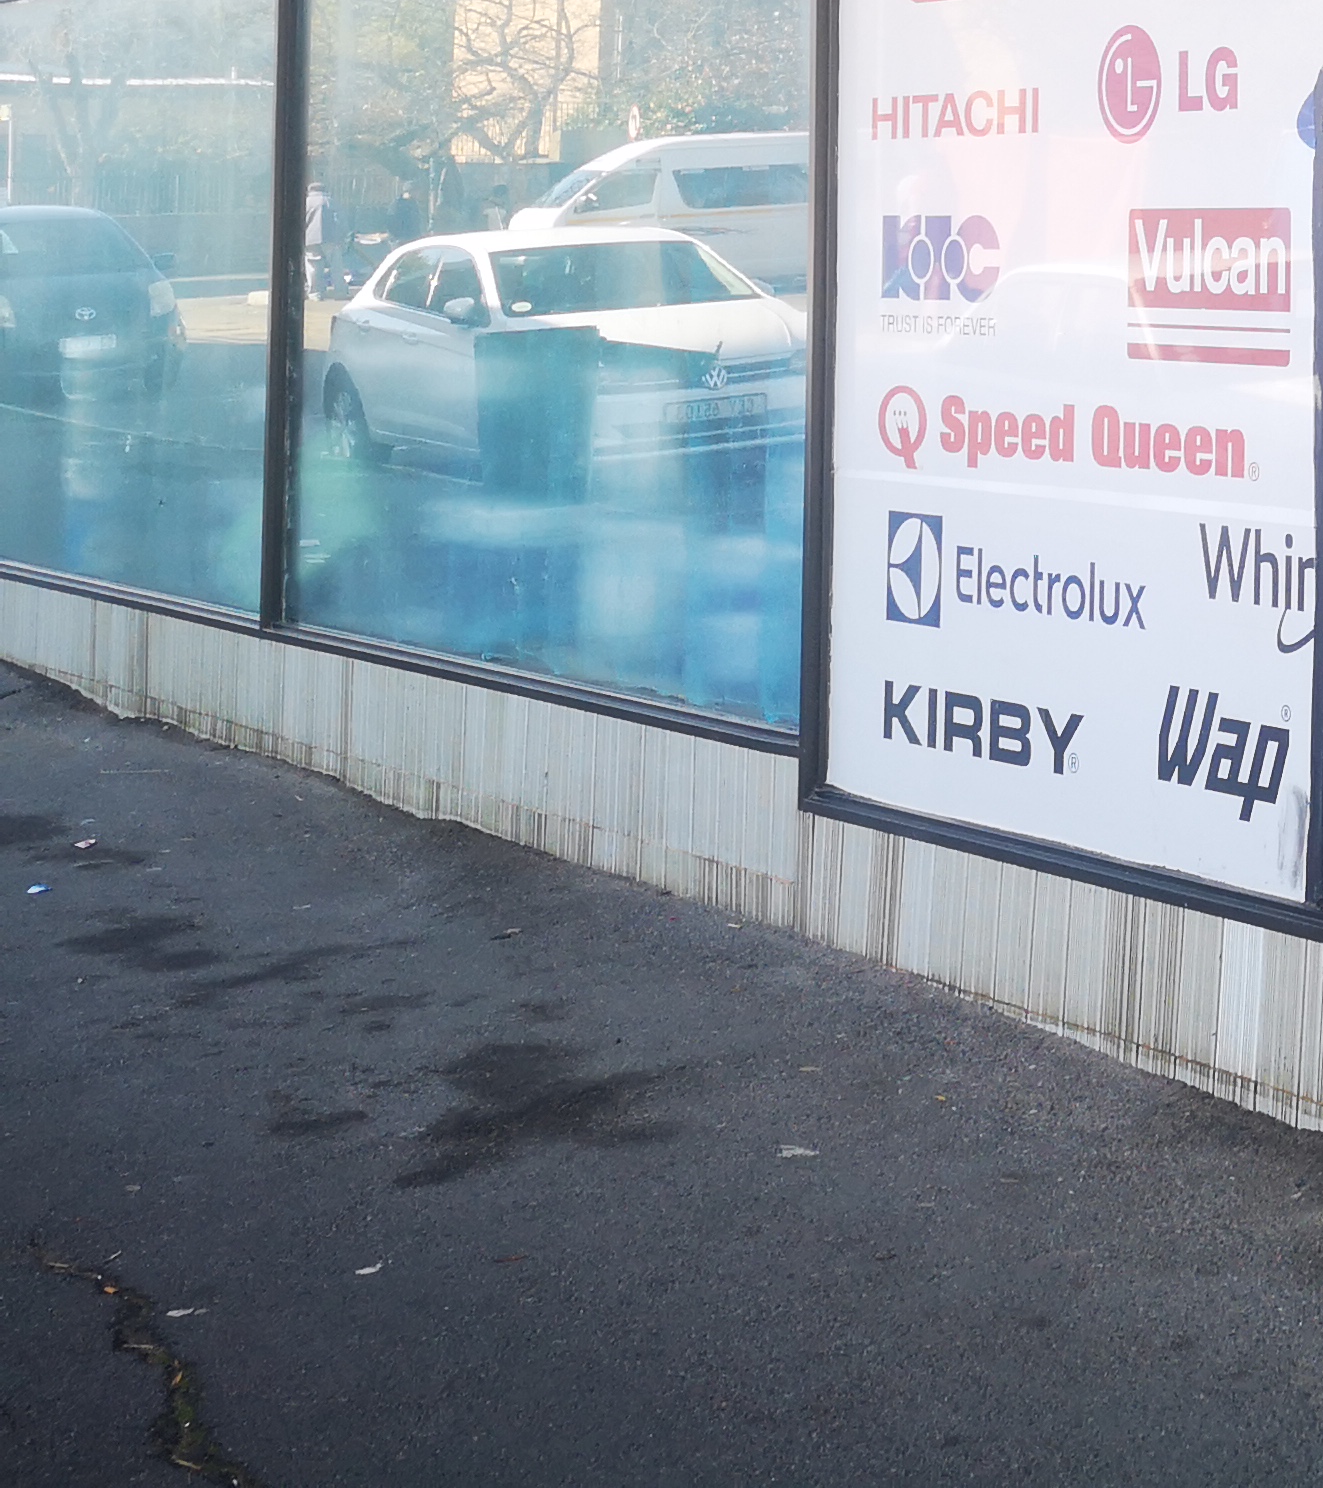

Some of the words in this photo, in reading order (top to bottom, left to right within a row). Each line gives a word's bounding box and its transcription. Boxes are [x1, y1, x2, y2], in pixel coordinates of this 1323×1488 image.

[871, 87, 1040, 141] HITACHI
[1178, 46, 1240, 113] LG
[1134, 218, 1287, 296] Vulcan
[880, 314, 918, 333] TRUST
[922, 316, 933, 334] IS
[937, 316, 997, 337] FOREVER
[940, 394, 1076, 469] Speed
[956, 545, 1147, 630] Electrolux
